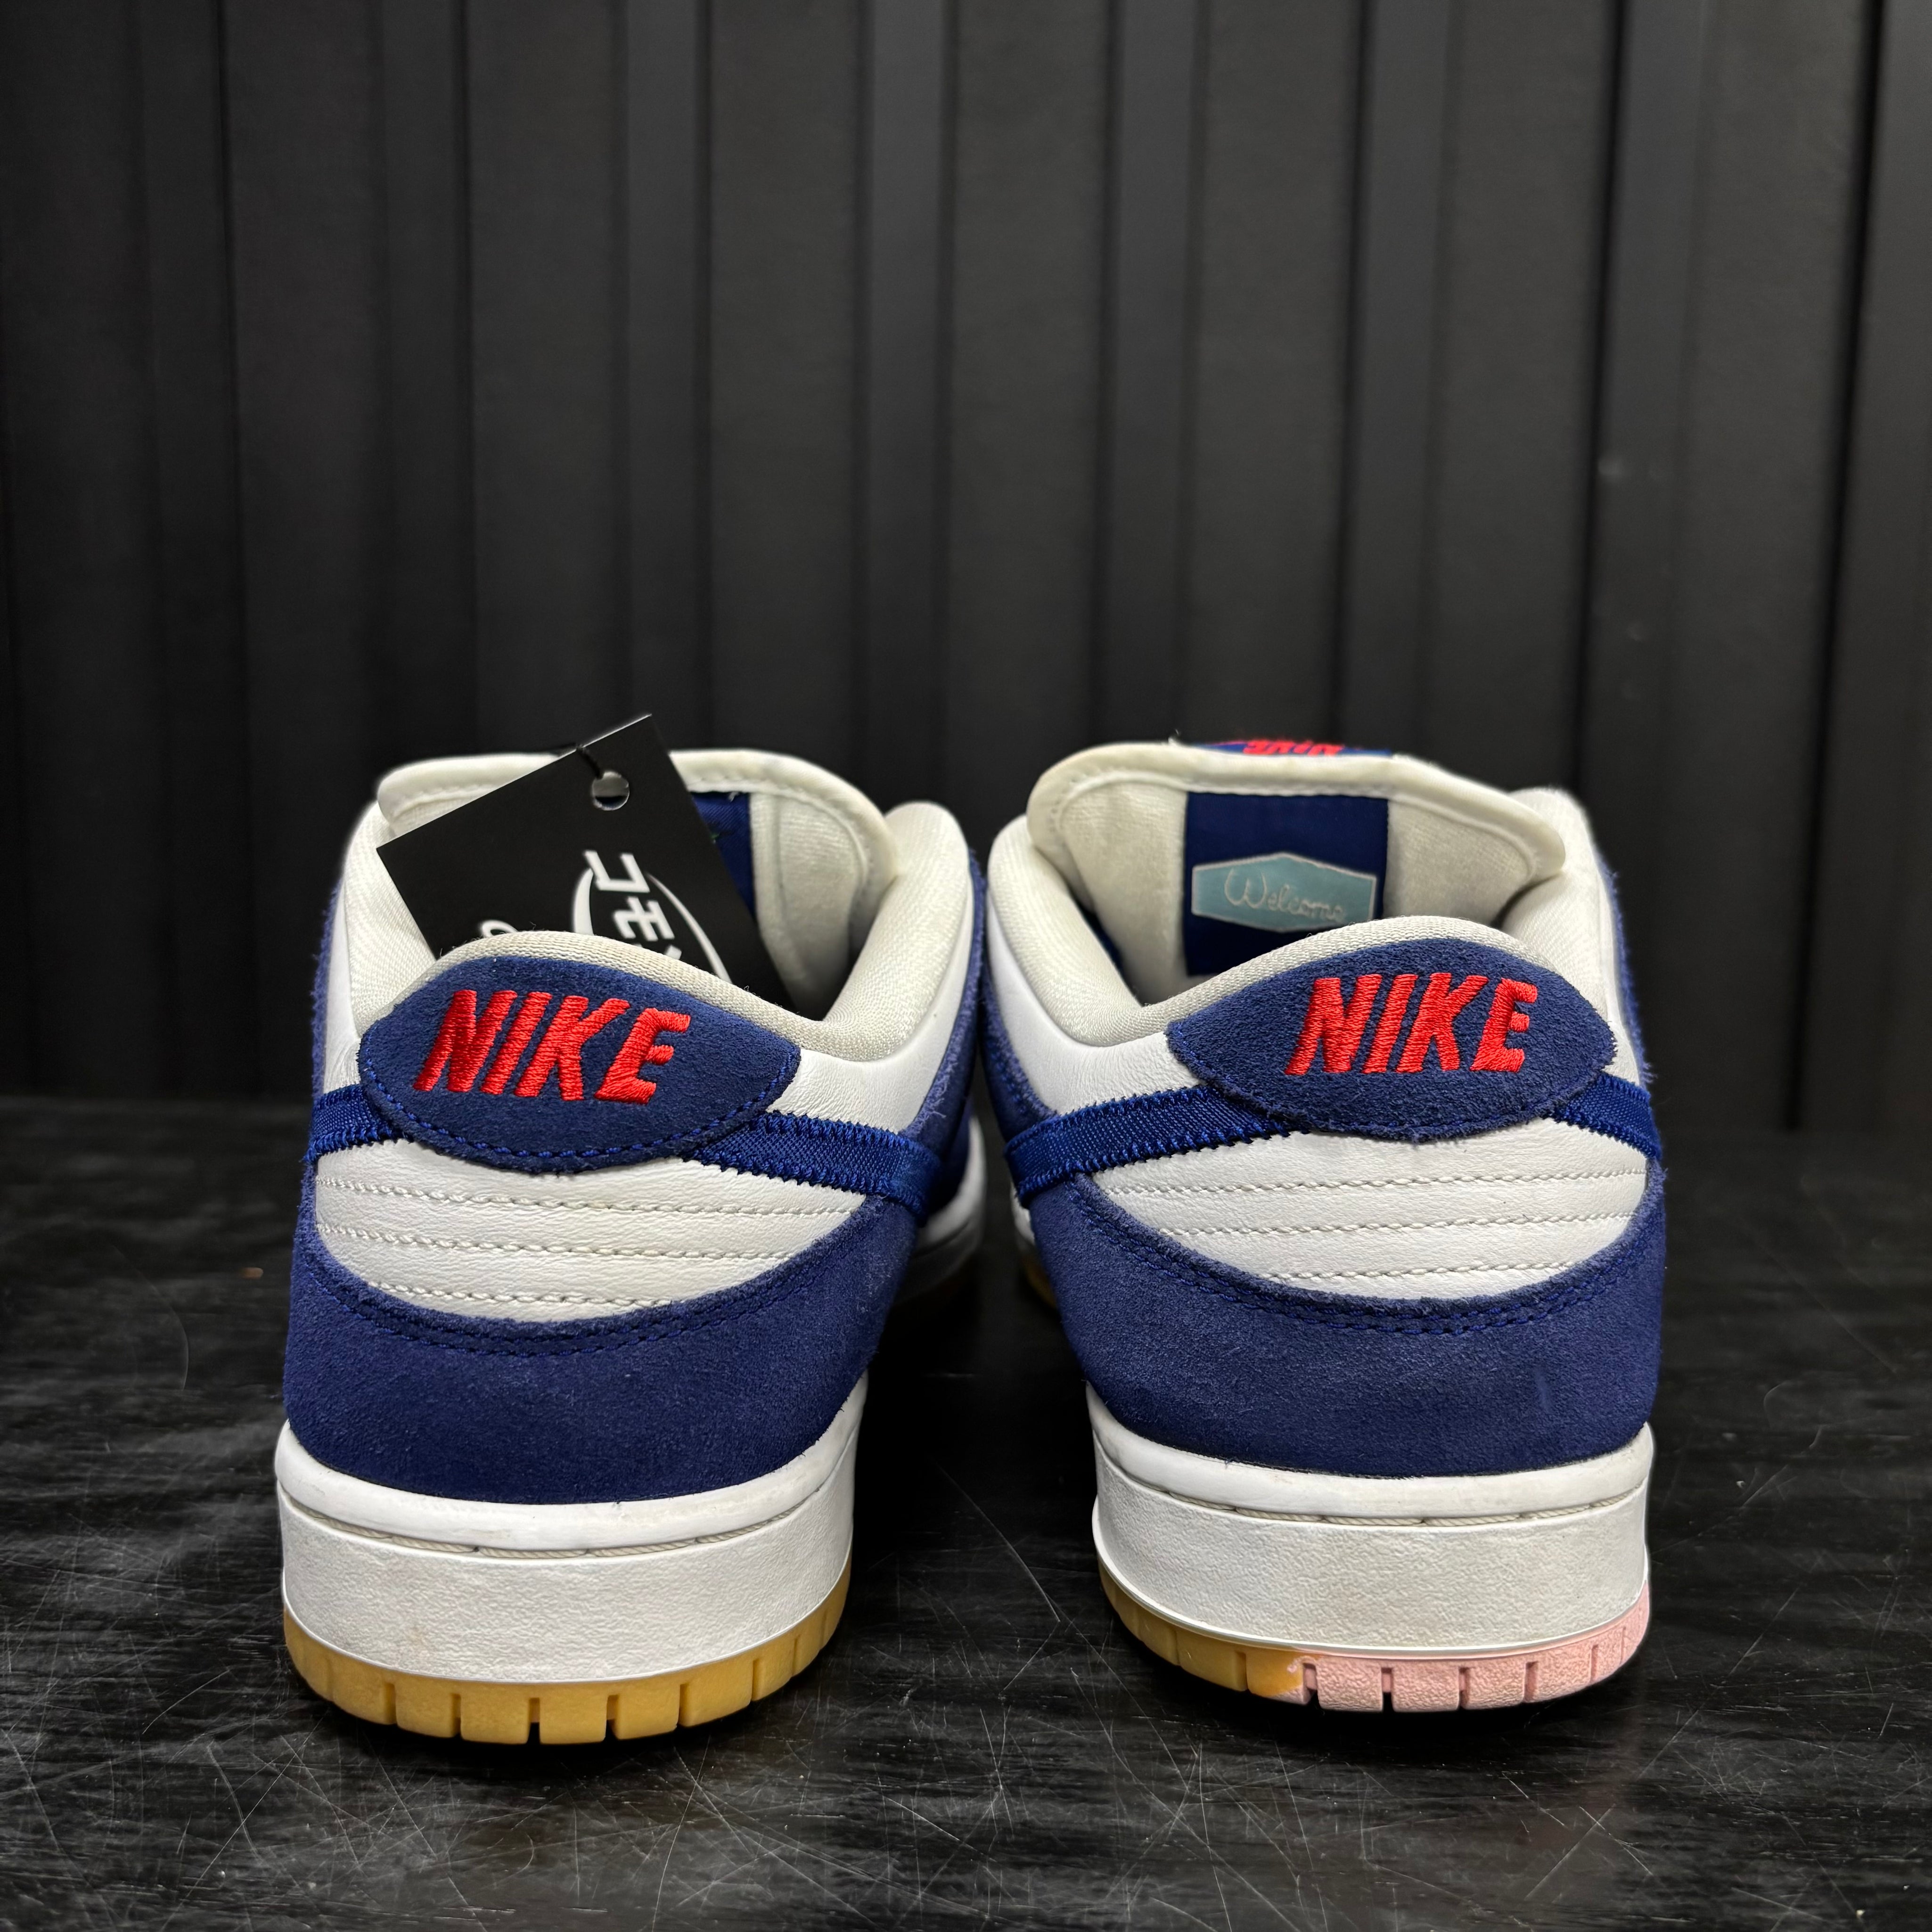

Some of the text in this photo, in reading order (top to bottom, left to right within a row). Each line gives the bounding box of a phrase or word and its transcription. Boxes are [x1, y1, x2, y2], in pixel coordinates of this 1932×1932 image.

[1225, 868, 1346, 922] Welcome
[412, 990, 691, 1105] NIKE
[1284, 973, 1538, 1075] NIKE
